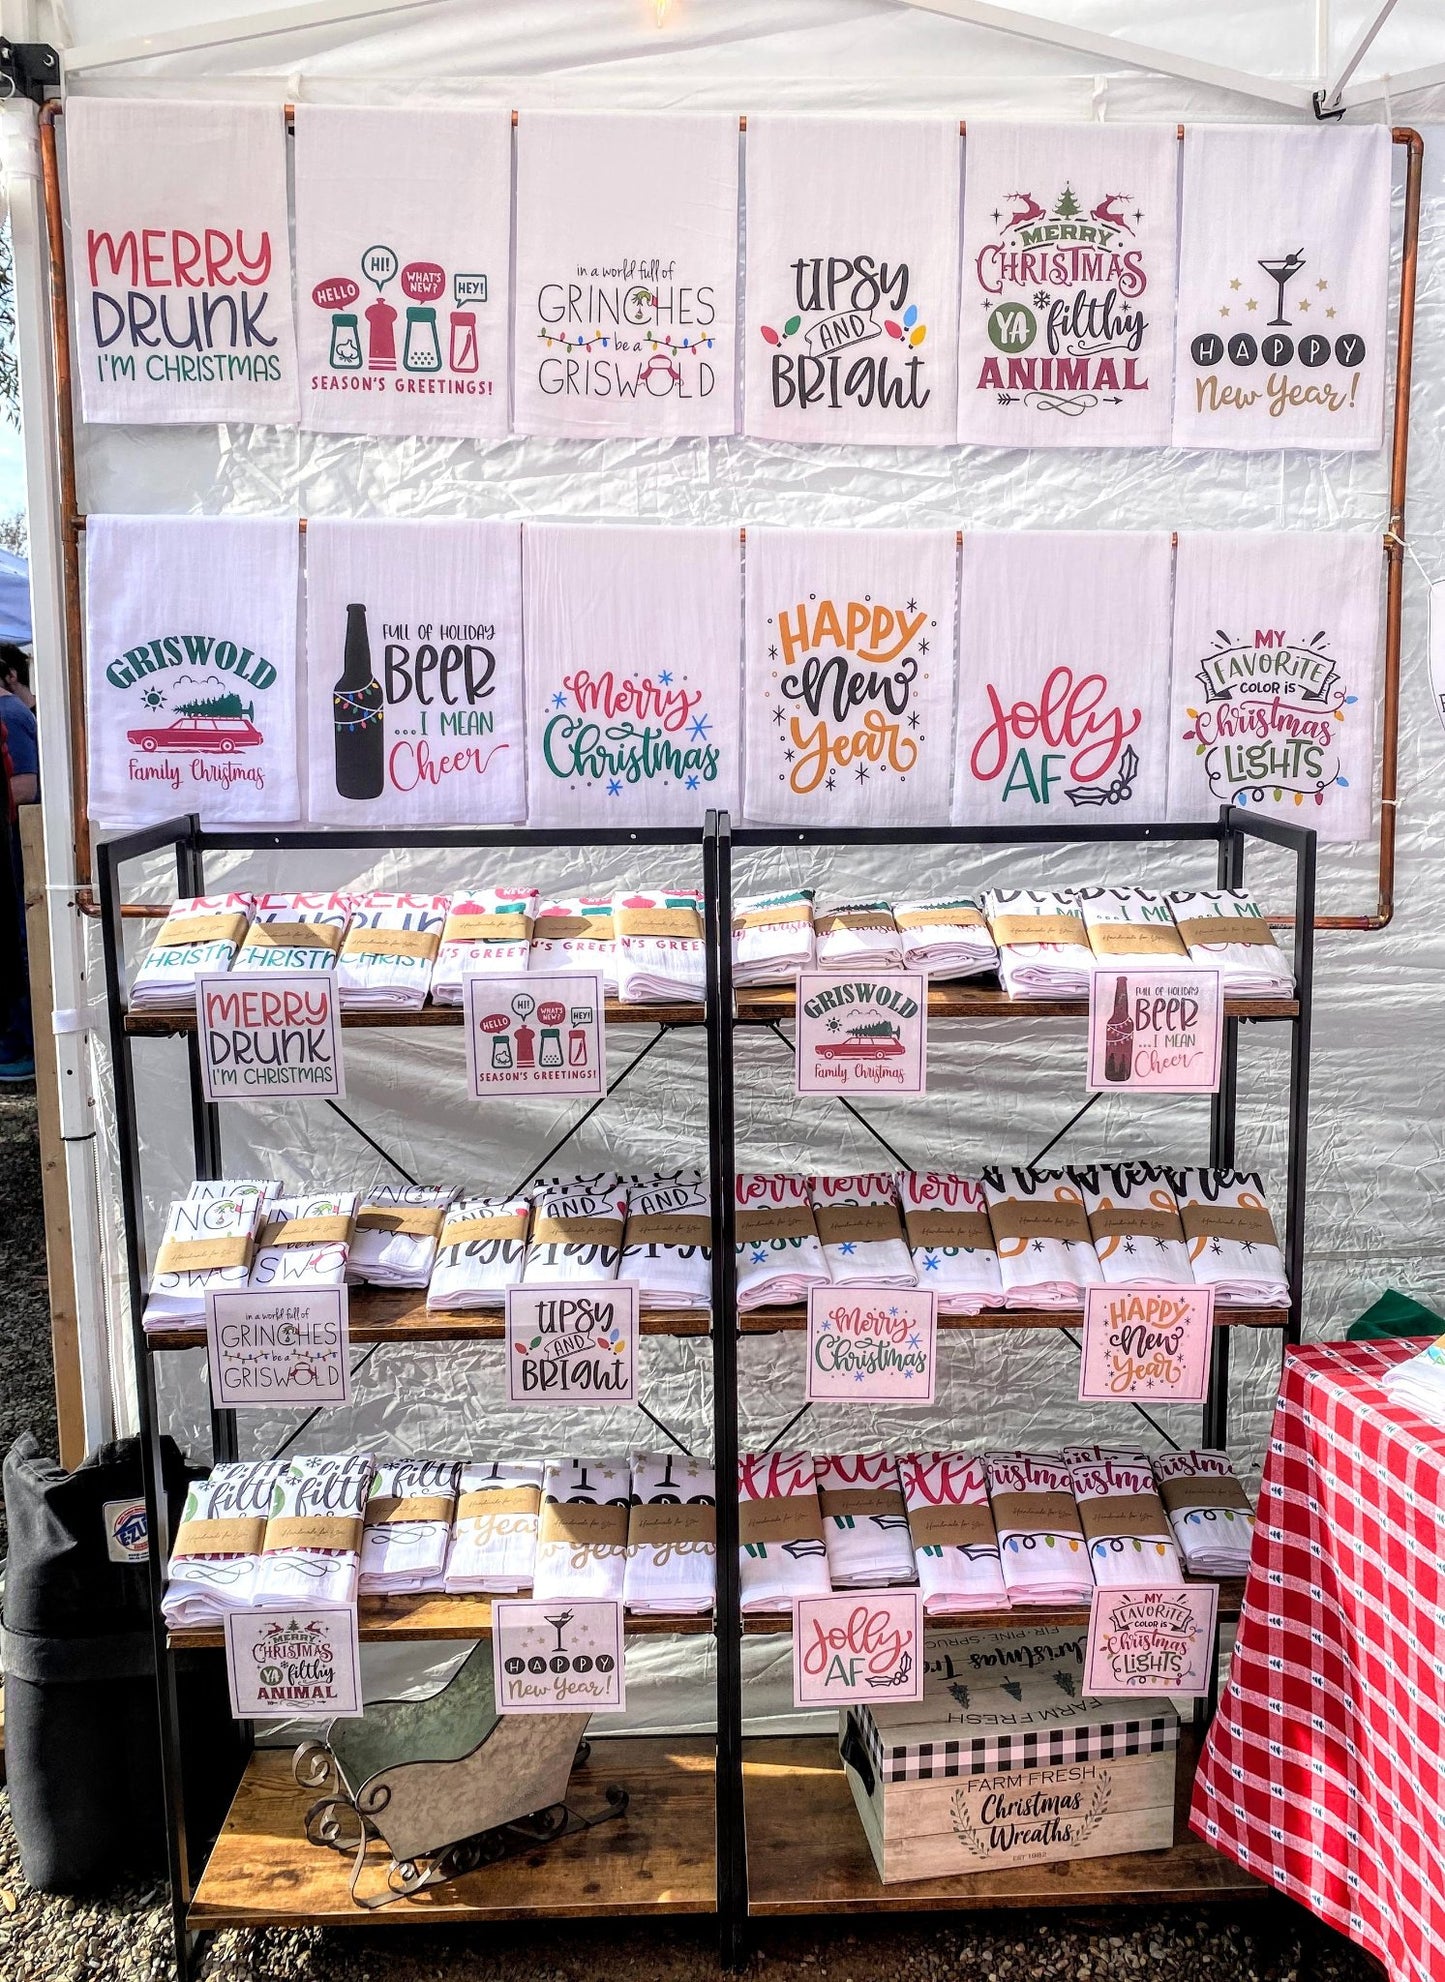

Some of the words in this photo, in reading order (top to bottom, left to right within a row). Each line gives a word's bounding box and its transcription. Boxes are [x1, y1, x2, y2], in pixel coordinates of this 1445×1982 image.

[1021, 225, 1114, 247] MERRY
[371, 258, 390, 272] HI!
[406, 272, 442, 283] WHAT'S
[577, 265, 587, 278] in
[590, 266, 600, 278] a
[602, 259, 634, 281] world
[638, 260, 659, 281] full
[661, 260, 675, 279] of
[975, 243, 1147, 298] CHRISTMAS
[317, 285, 356, 303] HELLO
[410, 282, 437, 293] NEW?
[458, 282, 484, 295] HEY!
[538, 284, 715, 326] GRINCHES
[819, 314, 865, 350] AND
[996, 311, 1030, 344] YA
[1047, 289, 1148, 356] filthy
[614, 332, 630, 351] be
[633, 342, 642, 351] a
[1199, 338, 1358, 363] HAPPY
[97, 355, 136, 383] I'M
[146, 355, 281, 383] CHRISTMAS
[538, 355, 715, 399] GRISWOLD
[976, 357, 1148, 390] ANIMAL
[311, 376, 386, 392] SEASON'S
[395, 378, 492, 396] GREETINGS!
[1196, 375, 1263, 412] New
[1266, 372, 1360, 417] Year!
[382, 624, 411, 641] FULL
[418, 624, 432, 641] OF
[440, 624, 496, 641] HOLIDAY
[779, 600, 927, 665] HAPPY
[1255, 629, 1286, 648] MY
[106, 635, 278, 690] GRISWOLD
[563, 670, 702, 732] Merry
[781, 656, 918, 722] New
[1240, 682, 1281, 694] COLOR
[440, 711, 494, 736] MEAN
[971, 666, 1141, 783] Jolly
[1193, 699, 1335, 746] Christmas
[544, 714, 720, 783] Christmas
[128, 758, 184, 789] Family
[191, 759, 265, 790] Christmas
[389, 740, 509, 792] Cheer
[1002, 747, 1066, 804] AF
[804, 983, 918, 1018] GRISWOLD
[1168, 987, 1199, 996] HOLIDAY
[517, 1001, 530, 1009] HI!
[483, 1017, 508, 1030] HELLO
[1165, 1034, 1195, 1047] MEAN
[212, 1070, 237, 1085] I'M
[244, 1066, 332, 1085] CHRISTMAS
[479, 1072, 528, 1081] SEASON'S
[534, 1070, 596, 1079] GREETINGS!
[815, 1064, 847, 1083] Family
[855, 1064, 905, 1083] Christmas
[1135, 1050, 1203, 1077] Cheer
[829, 1307, 916, 1343] Merry
[1110, 1298, 1190, 1329] HAPPY
[221, 1322, 337, 1347] GRINCHES
[554, 1335, 584, 1356] AND
[1110, 1325, 1184, 1358] New
[272, 1350, 284, 1361] be
[815, 1334, 927, 1374] Christmas
[225, 1362, 339, 1388] GRISWOLD
[1144, 1594, 1163, 1603] MY
[273, 1634, 316, 1643] MERRY
[804, 1607, 912, 1674] Jolly
[1107, 1629, 1187, 1655] Christmas
[252, 1642, 333, 1663] CHRISTMAS
[509, 1658, 609, 1671] HAPPY
[263, 1670, 280, 1682] YA
[288, 1660, 335, 1686] filthy
[824, 1655, 865, 1687] AF
[257, 1686, 337, 1699] ANIMAL
[509, 1679, 550, 1700] New
[553, 1675, 611, 1700] Year!
[948, 1713, 1032, 1725] FRESH
[967, 1776, 1023, 1793] FARM
[1028, 1765, 1097, 1785] FRESH
[981, 1790, 1083, 1825] Christmas
[989, 1818, 1073, 1851] Wreaths
